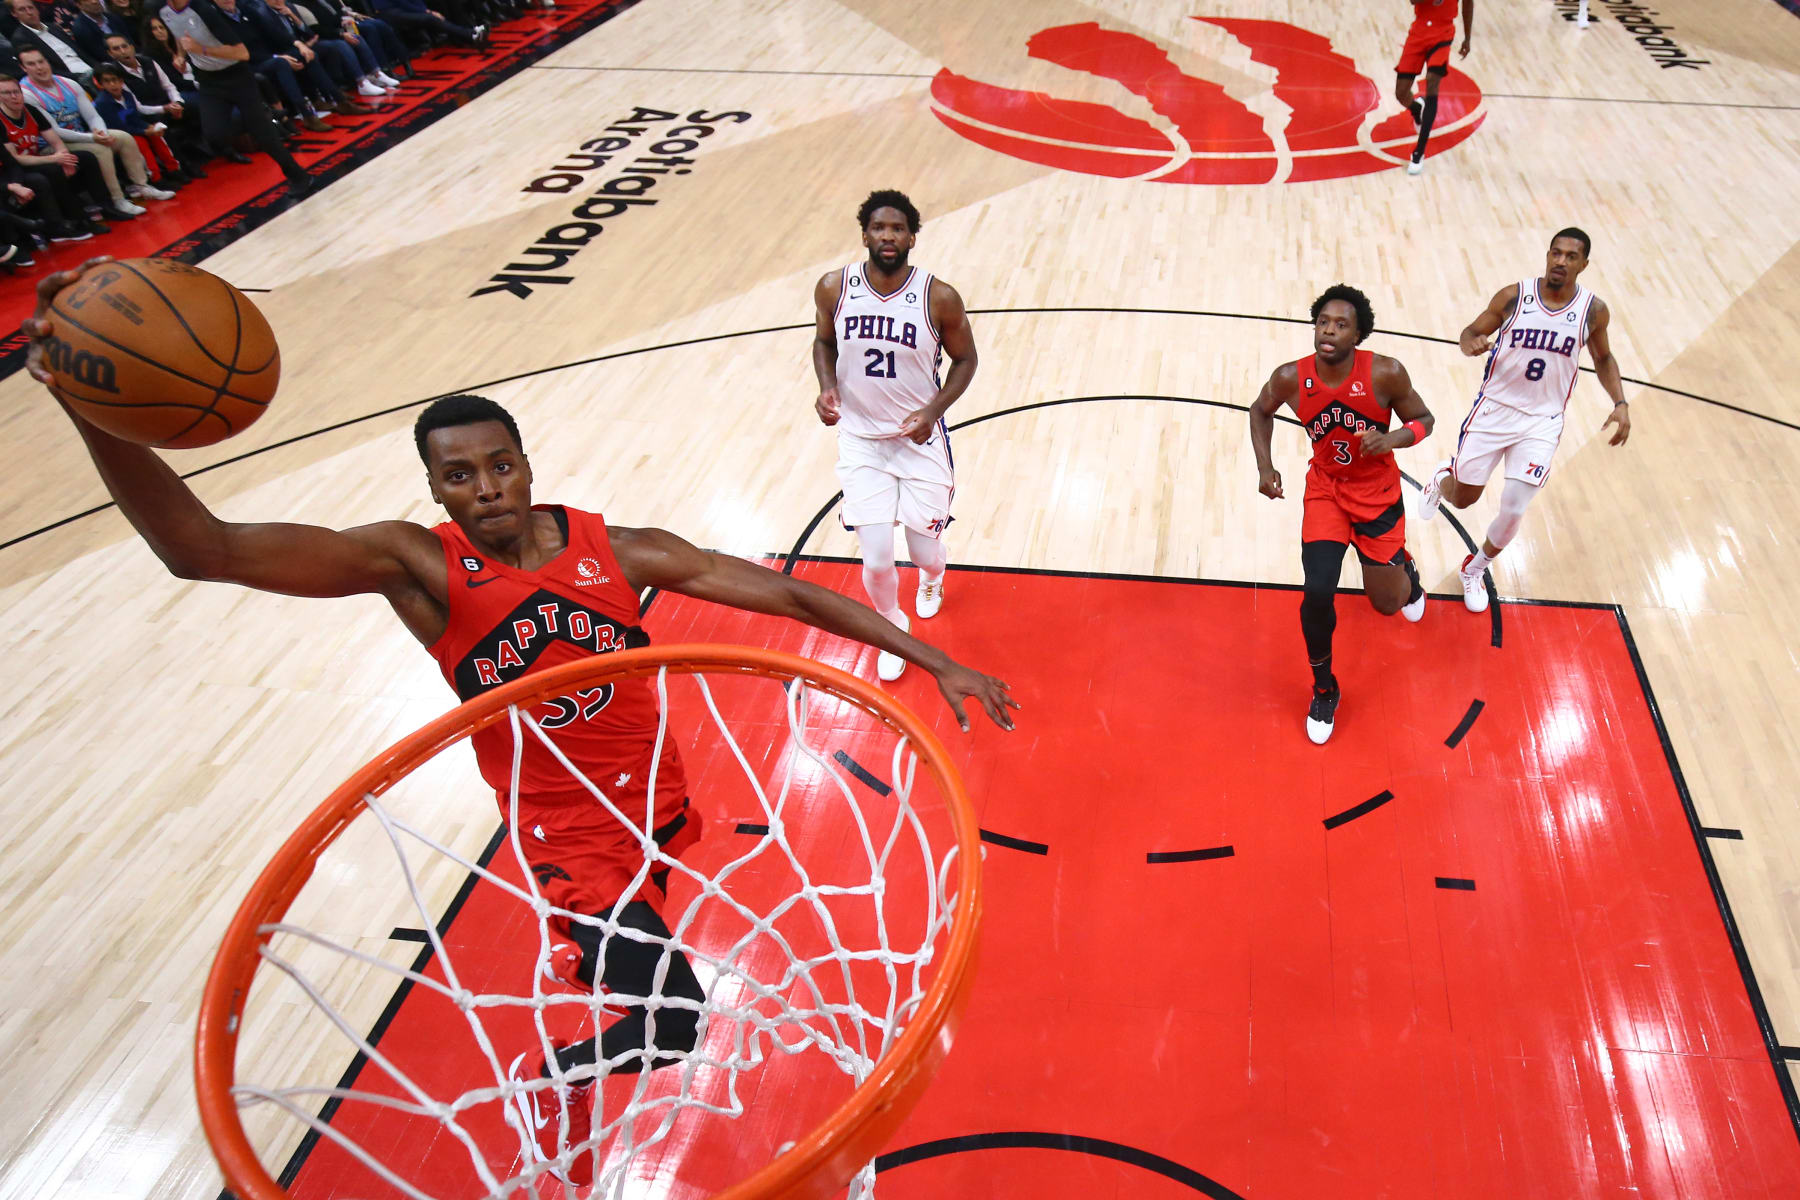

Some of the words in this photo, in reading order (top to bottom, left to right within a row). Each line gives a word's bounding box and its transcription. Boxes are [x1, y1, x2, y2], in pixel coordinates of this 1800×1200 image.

[1600, 0, 1711, 69] tiabank
[520, 106, 680, 194] Arena
[468, 110, 752, 300] Scotiabank
[843, 315, 917, 350] PHILA
[1509, 328, 1576, 358] PHILA
[44, 336, 120, 394] Wil
[864, 348, 897, 379] 21
[1524, 358, 1547, 382] 8
[1332, 440, 1352, 465] 3
[1525, 462, 1544, 479] 76
[463, 558, 480, 571] 6
[574, 579, 593, 587] Sun
[593, 575, 610, 585] Life
